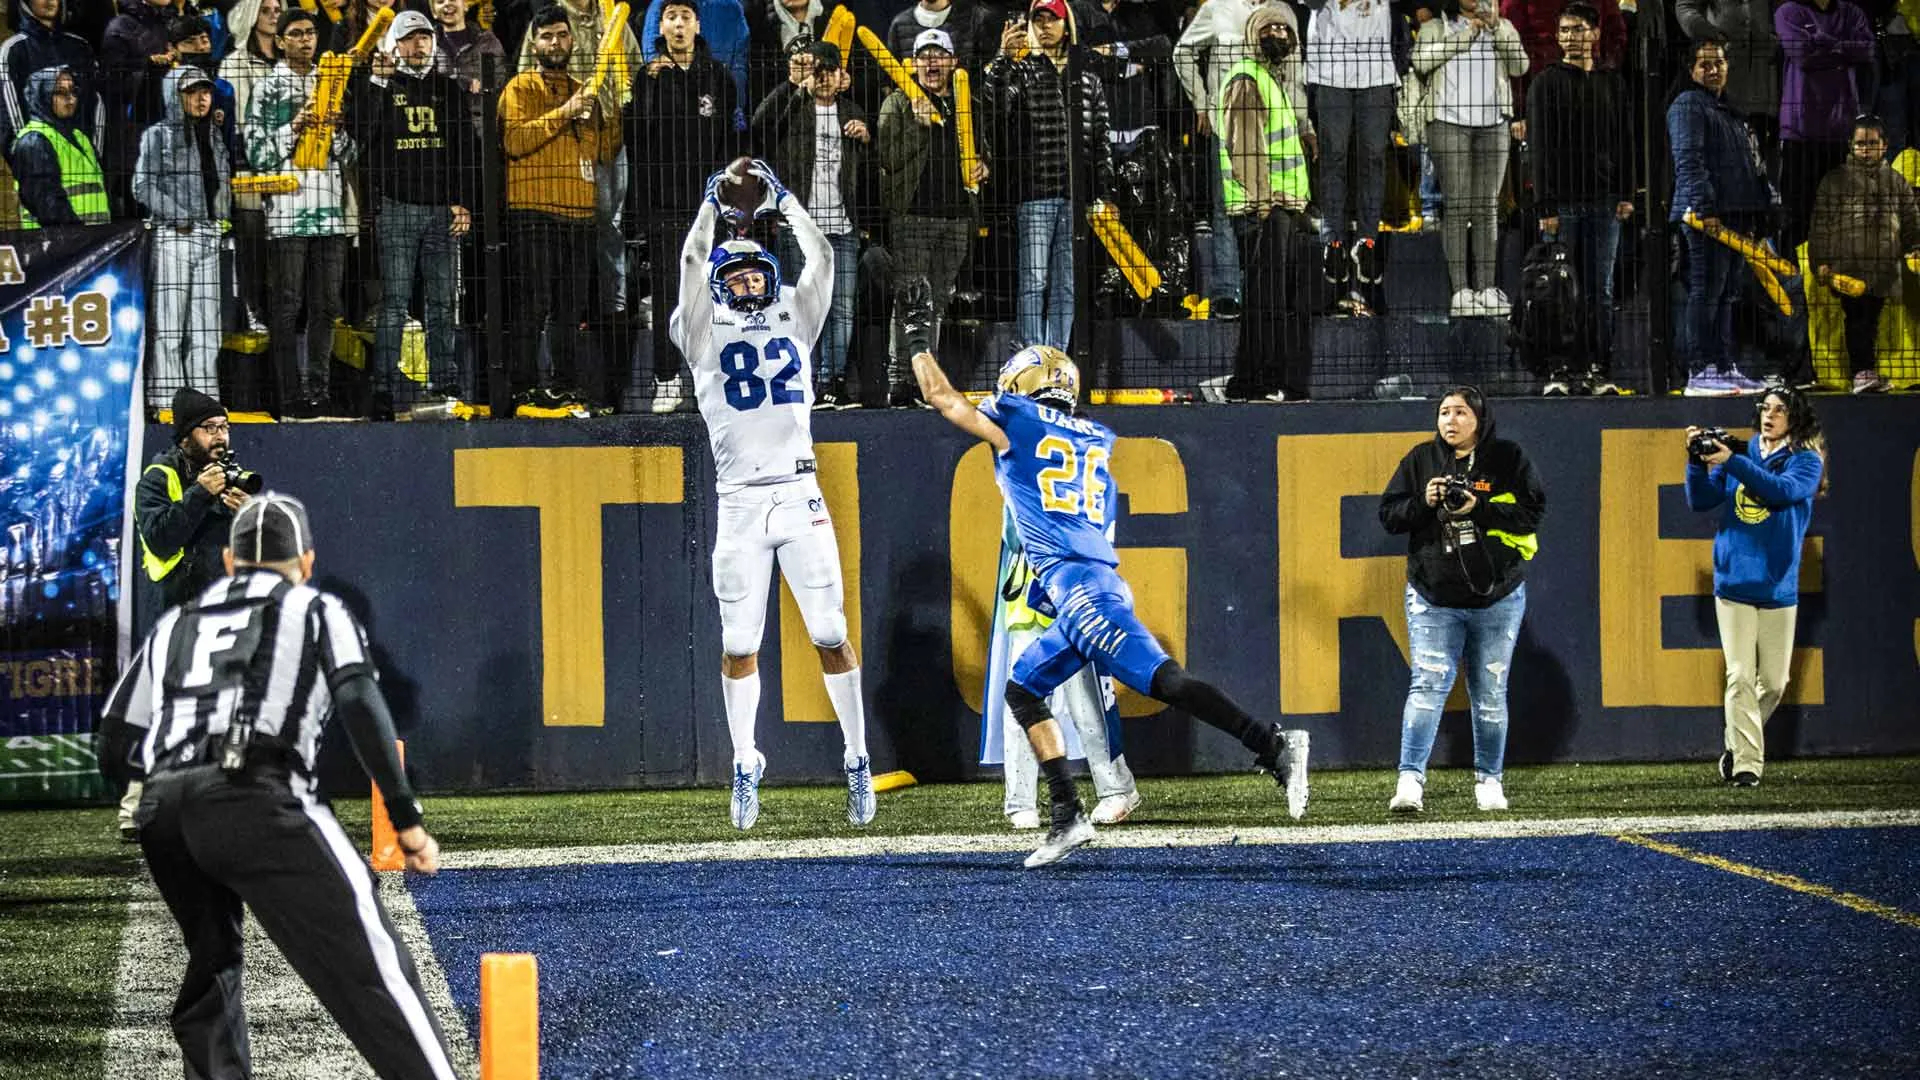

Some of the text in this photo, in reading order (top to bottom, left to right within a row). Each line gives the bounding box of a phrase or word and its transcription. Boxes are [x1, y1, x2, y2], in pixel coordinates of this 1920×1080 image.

[24, 291, 112, 348] #8
[719, 337, 804, 412] 82
[1035, 435, 1110, 526] 26
[182, 606, 252, 688] F
